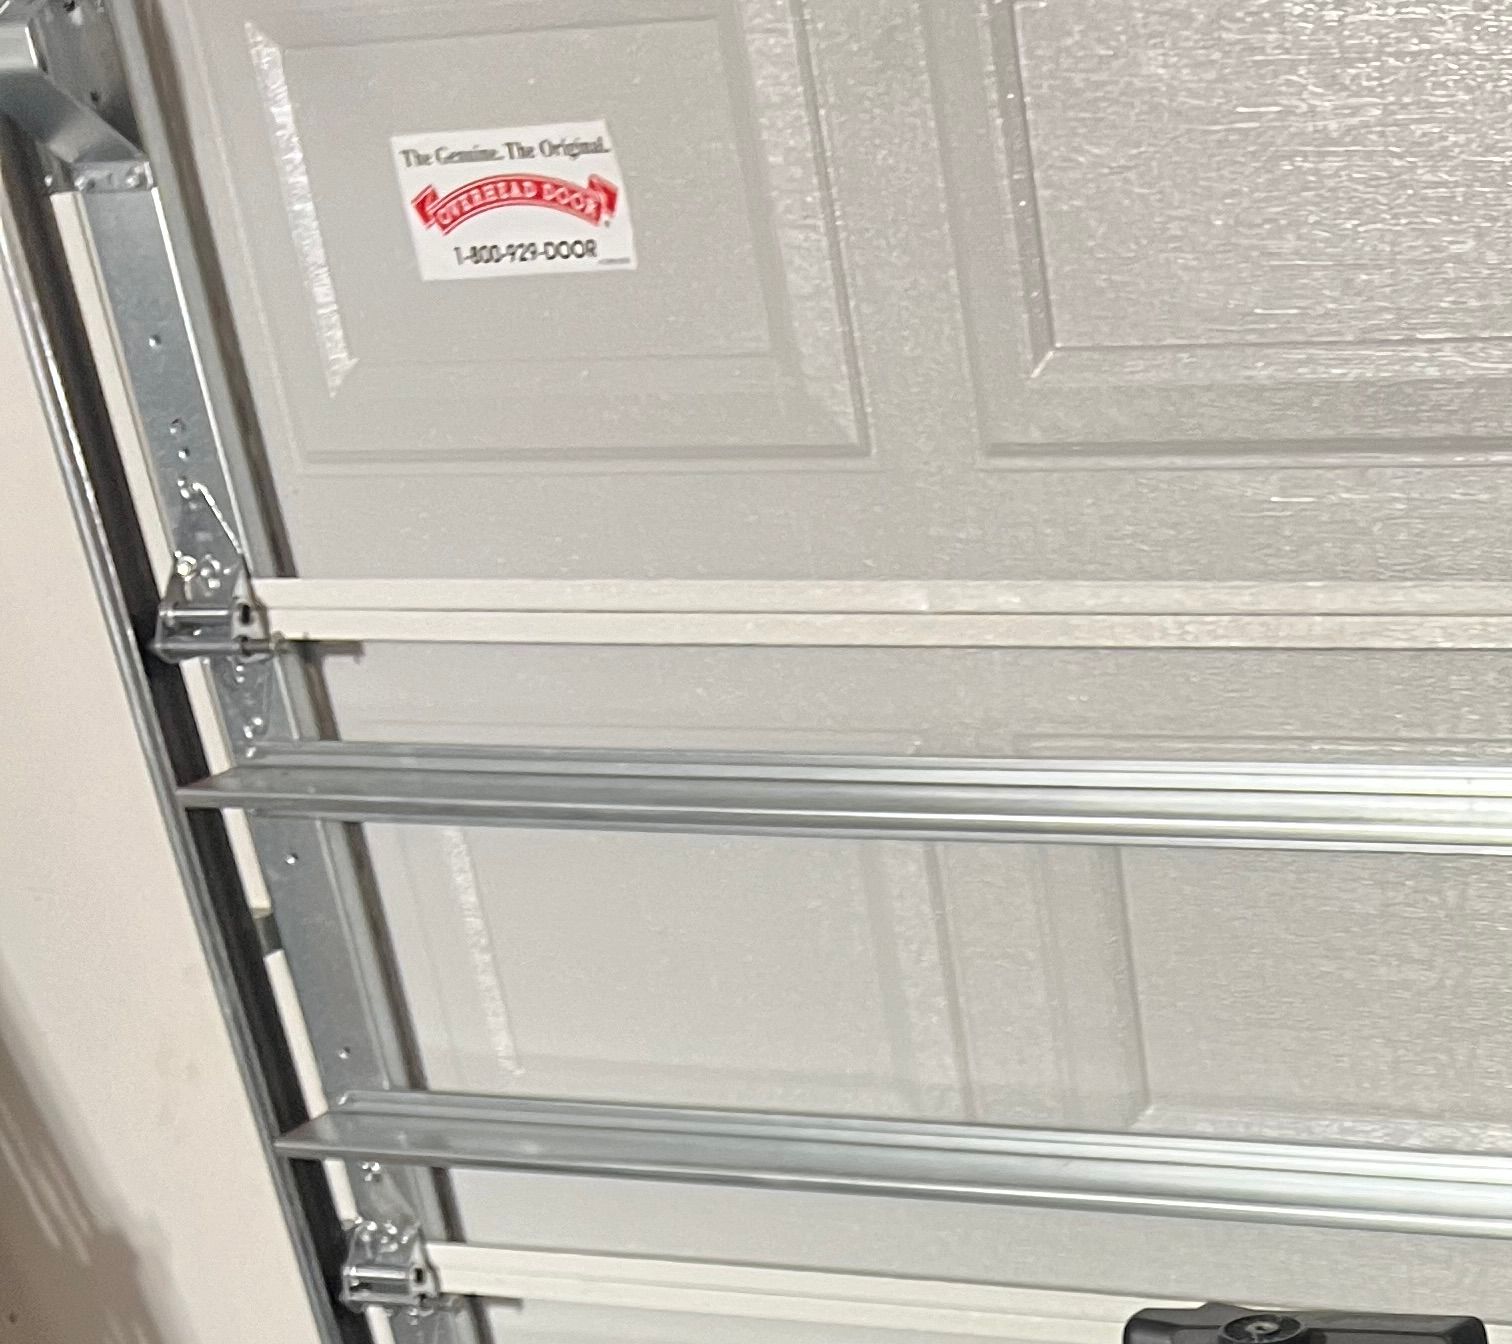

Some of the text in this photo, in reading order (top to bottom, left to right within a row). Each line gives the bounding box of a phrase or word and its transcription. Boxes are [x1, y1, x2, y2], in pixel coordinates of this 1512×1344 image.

[400, 149, 433, 168] The
[504, 141, 535, 160] The
[436, 180, 600, 225] OVERHEAD DOOR
[453, 239, 598, 265] 1-800-929-DOOR
